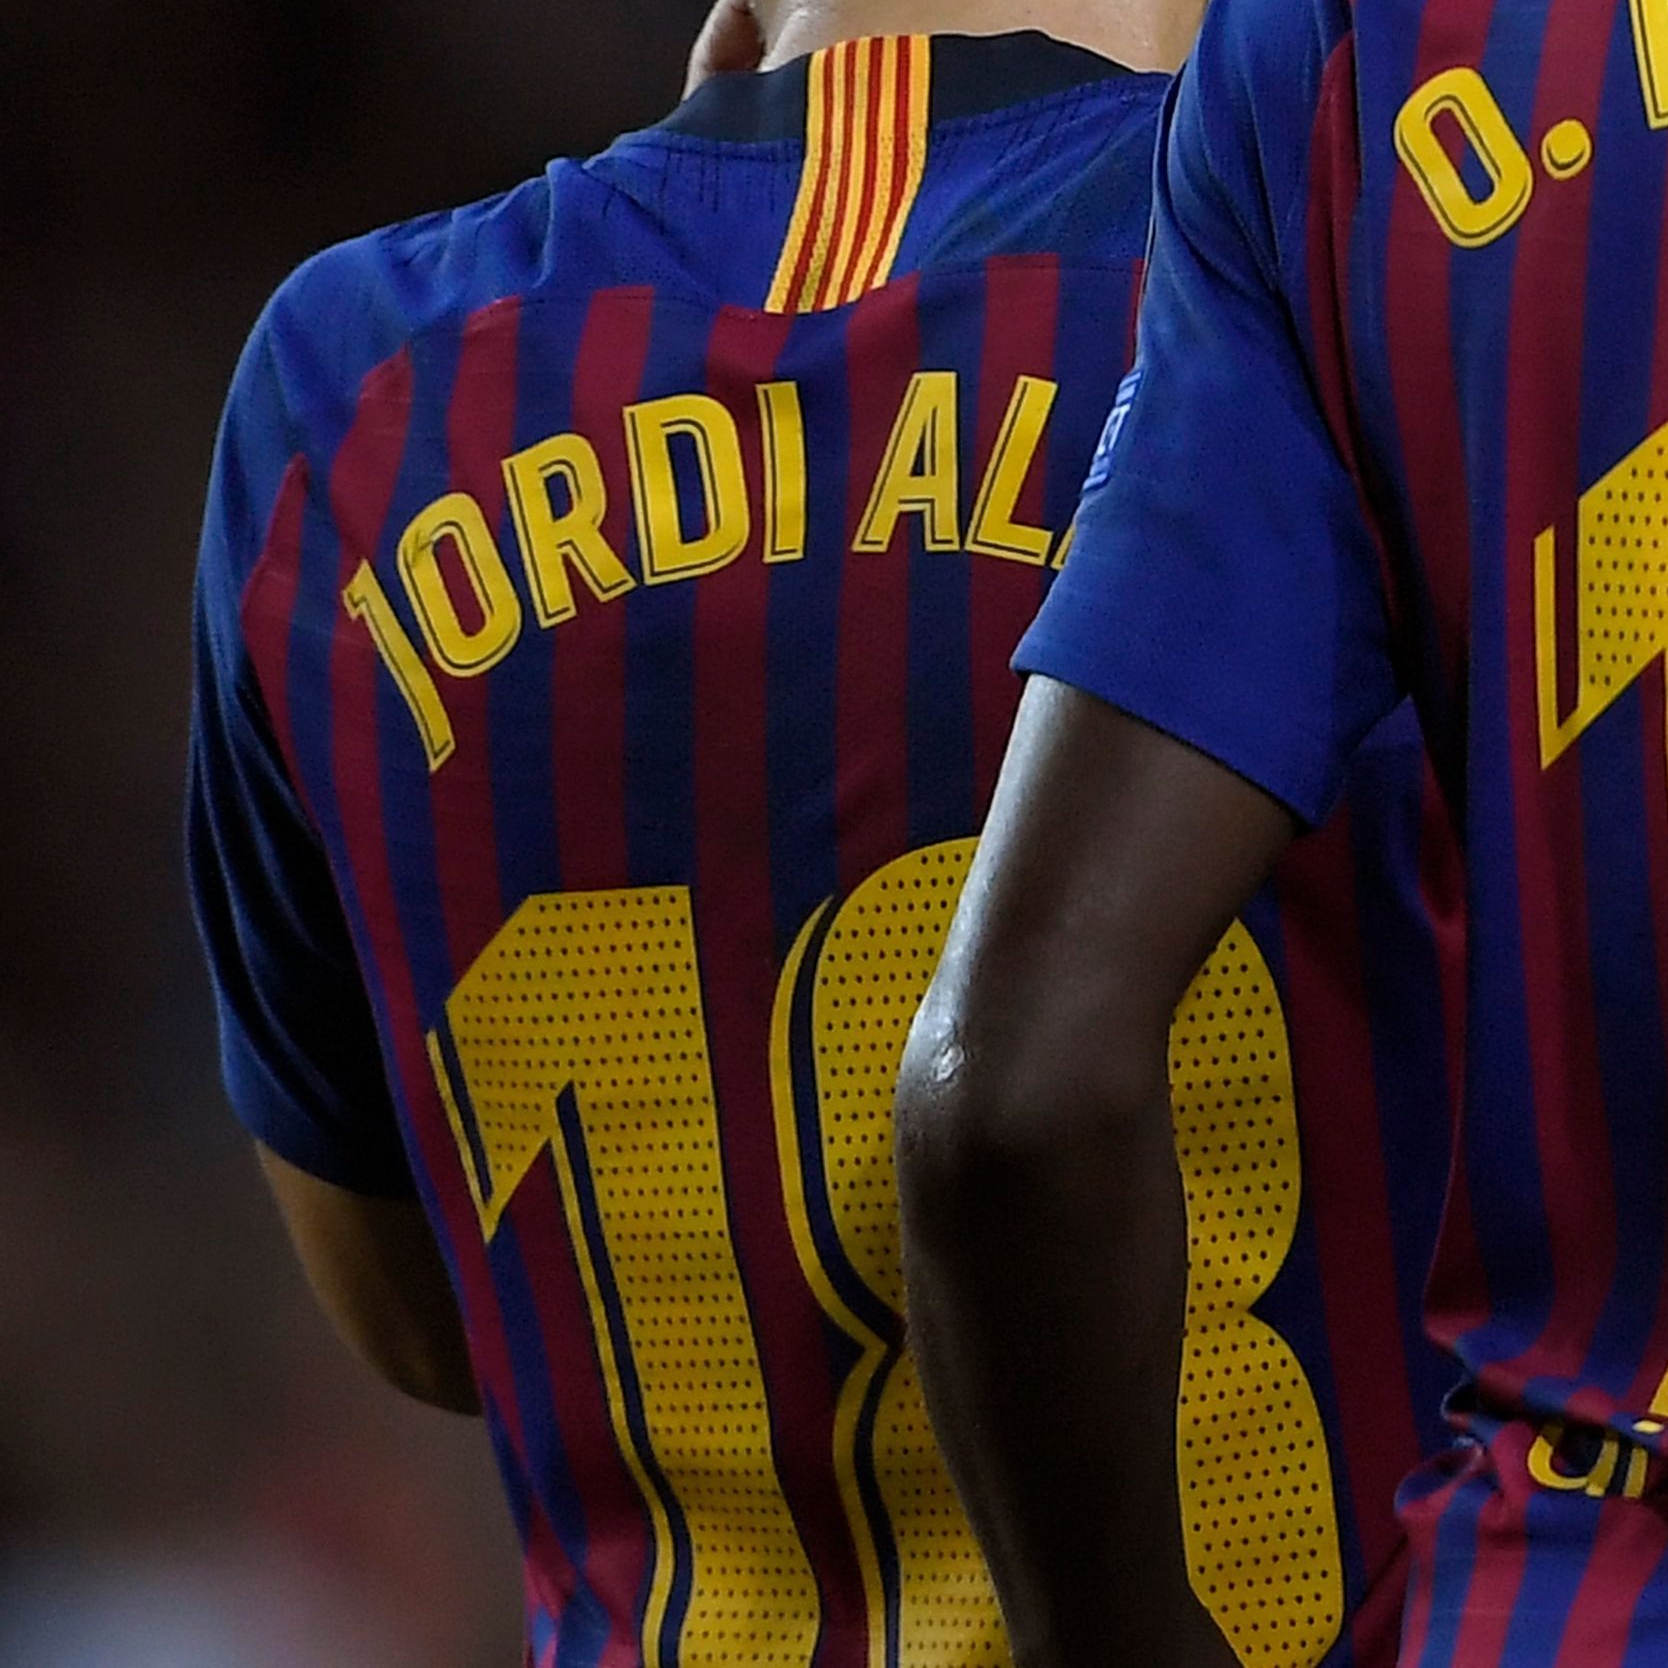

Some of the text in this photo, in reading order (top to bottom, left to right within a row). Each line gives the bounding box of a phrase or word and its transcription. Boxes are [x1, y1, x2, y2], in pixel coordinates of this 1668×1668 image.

[1394, 66, 1593, 249] O.
[342, 370, 1065, 773] JORDI AL
